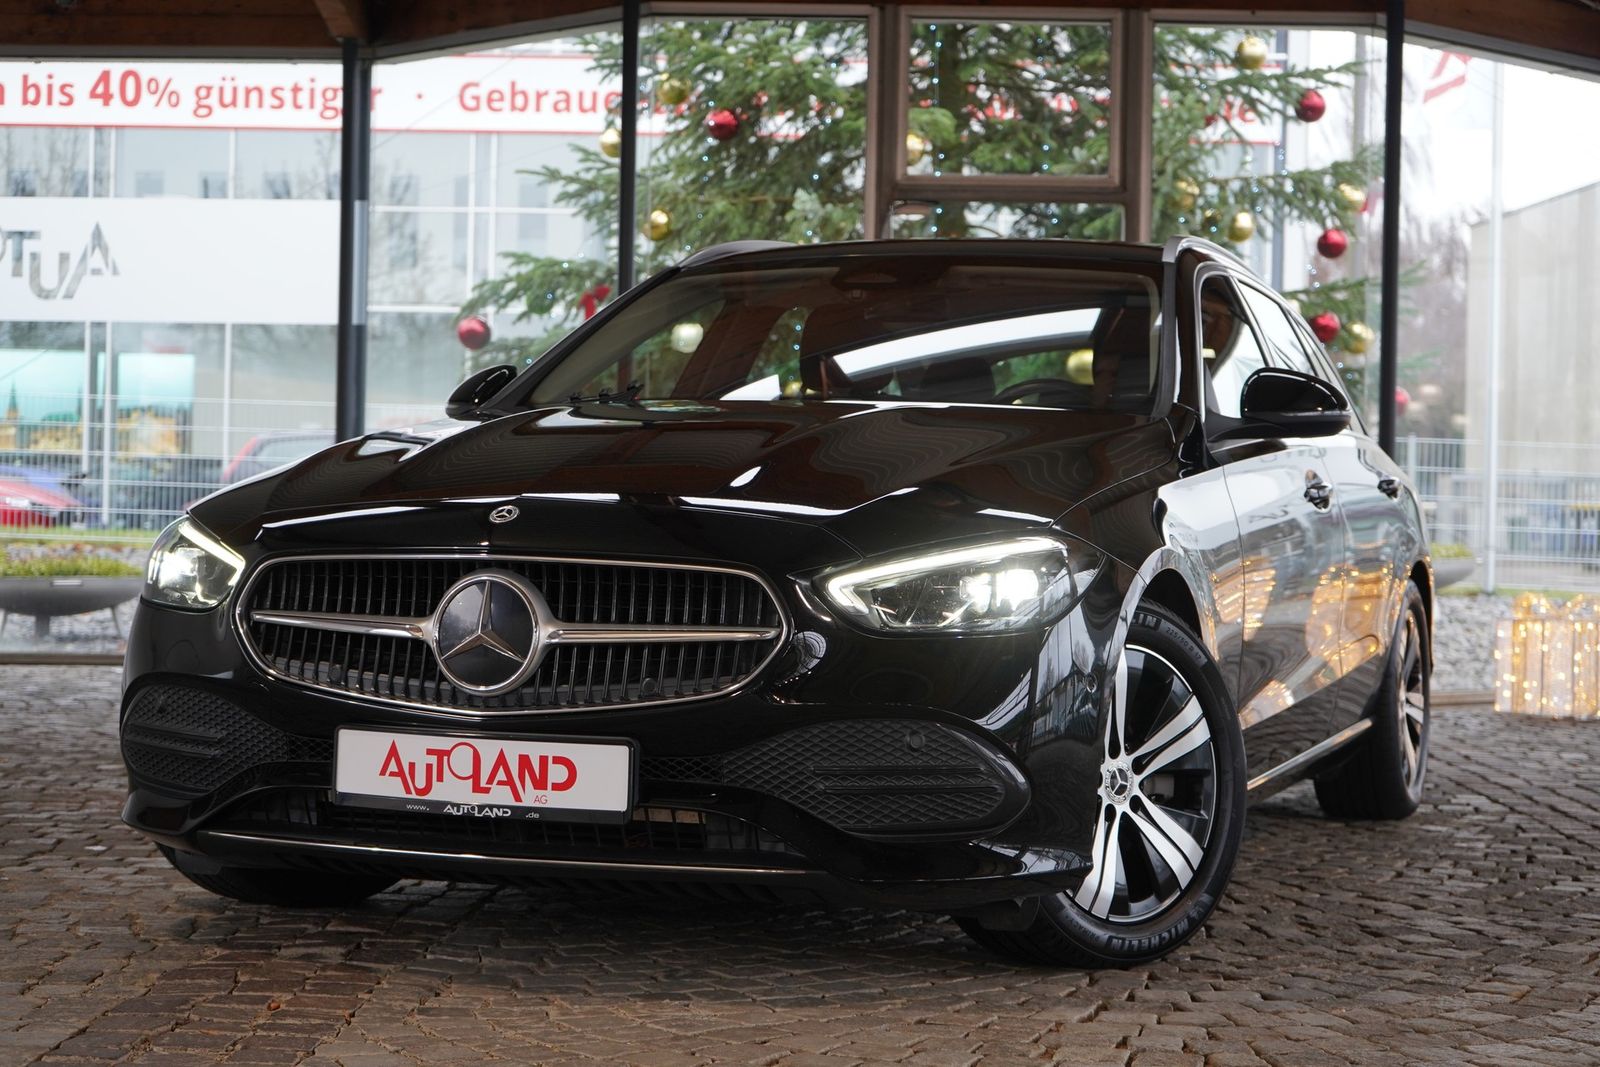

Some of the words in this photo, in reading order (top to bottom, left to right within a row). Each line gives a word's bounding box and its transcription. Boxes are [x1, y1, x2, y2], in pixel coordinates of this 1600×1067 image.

[21, 74, 75, 107] bis
[89, 69, 181, 109] 40%
[192, 76, 383, 120] günstigr
[533, 794, 549, 806] AG
[1110, 917, 1190, 952] MICHELIN
